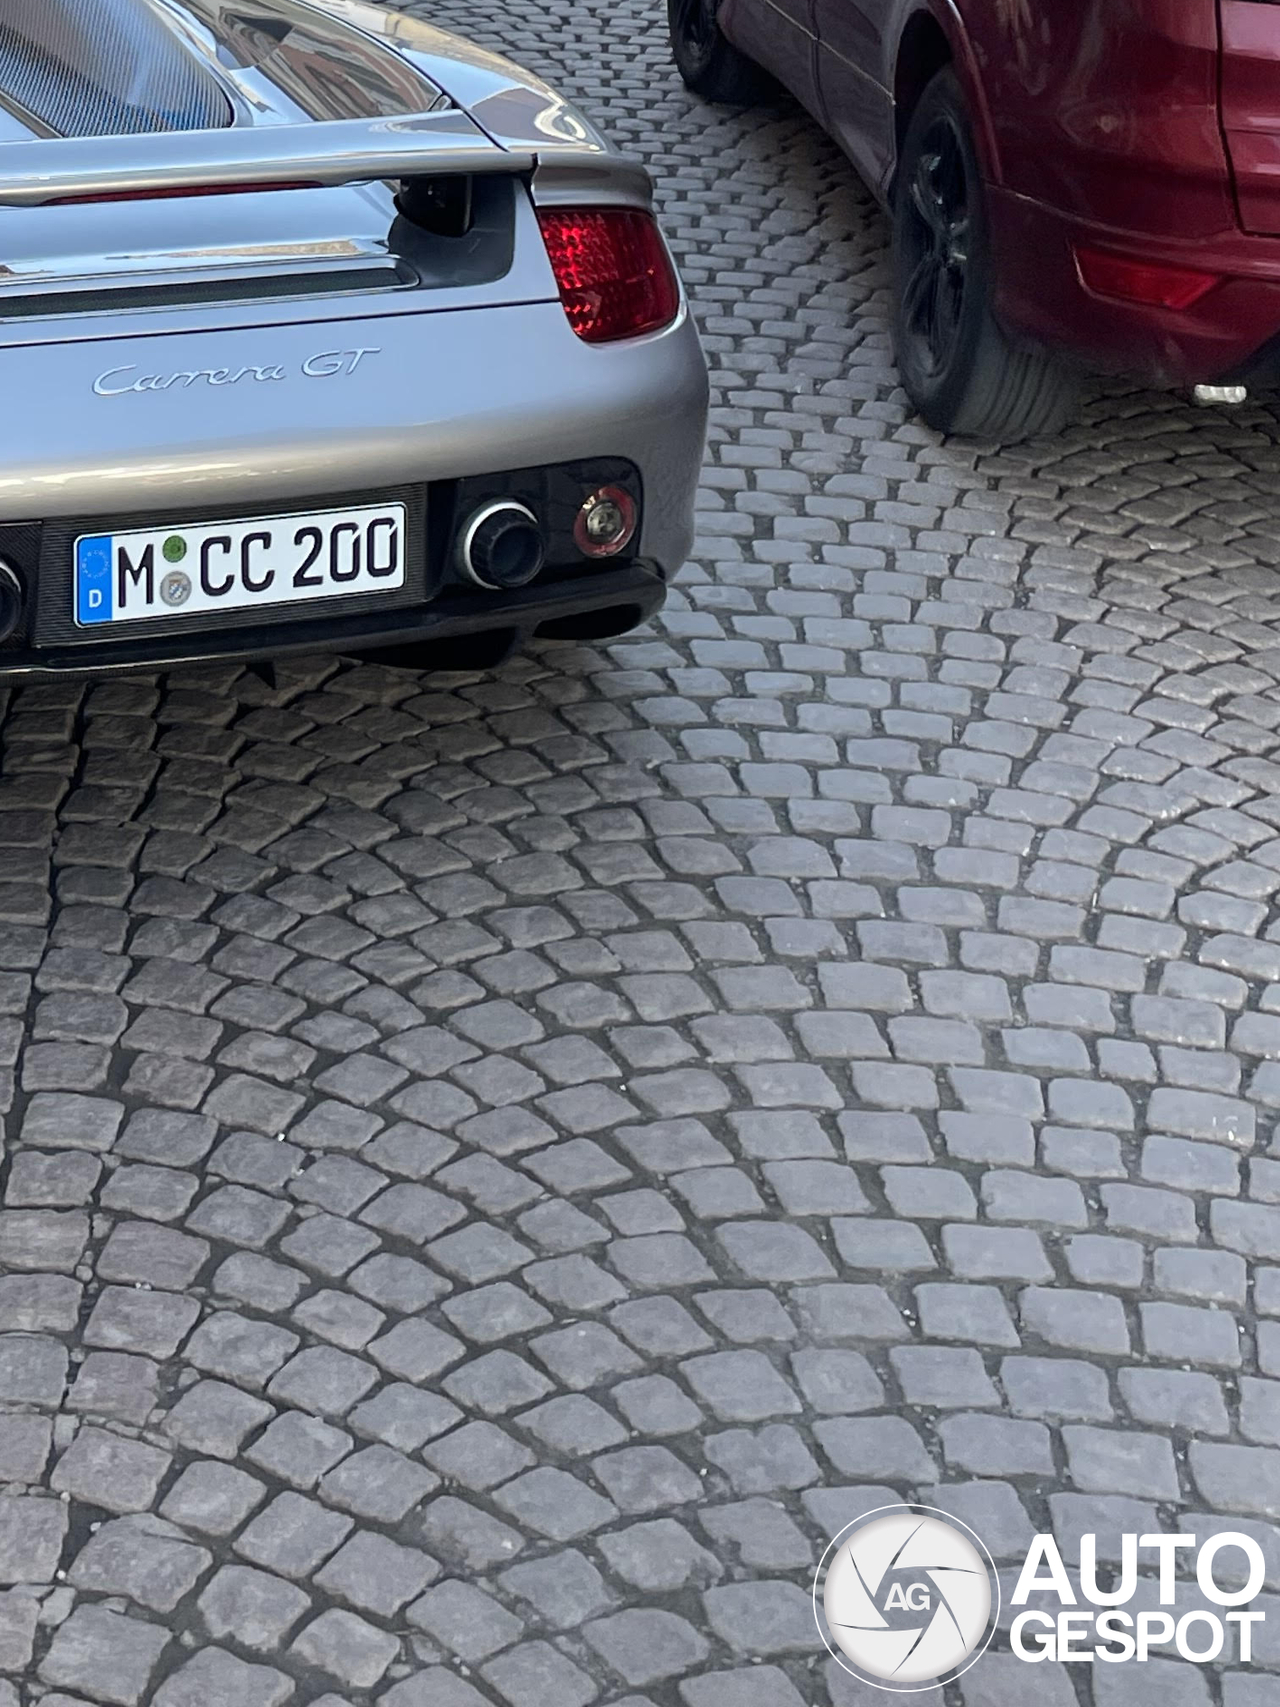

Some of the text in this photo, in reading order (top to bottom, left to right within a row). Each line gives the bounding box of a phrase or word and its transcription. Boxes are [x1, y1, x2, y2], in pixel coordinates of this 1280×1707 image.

[91, 347, 381, 396] Carrera GT
[117, 516, 398, 608] M CC 200
[88, 588, 103, 608] D
